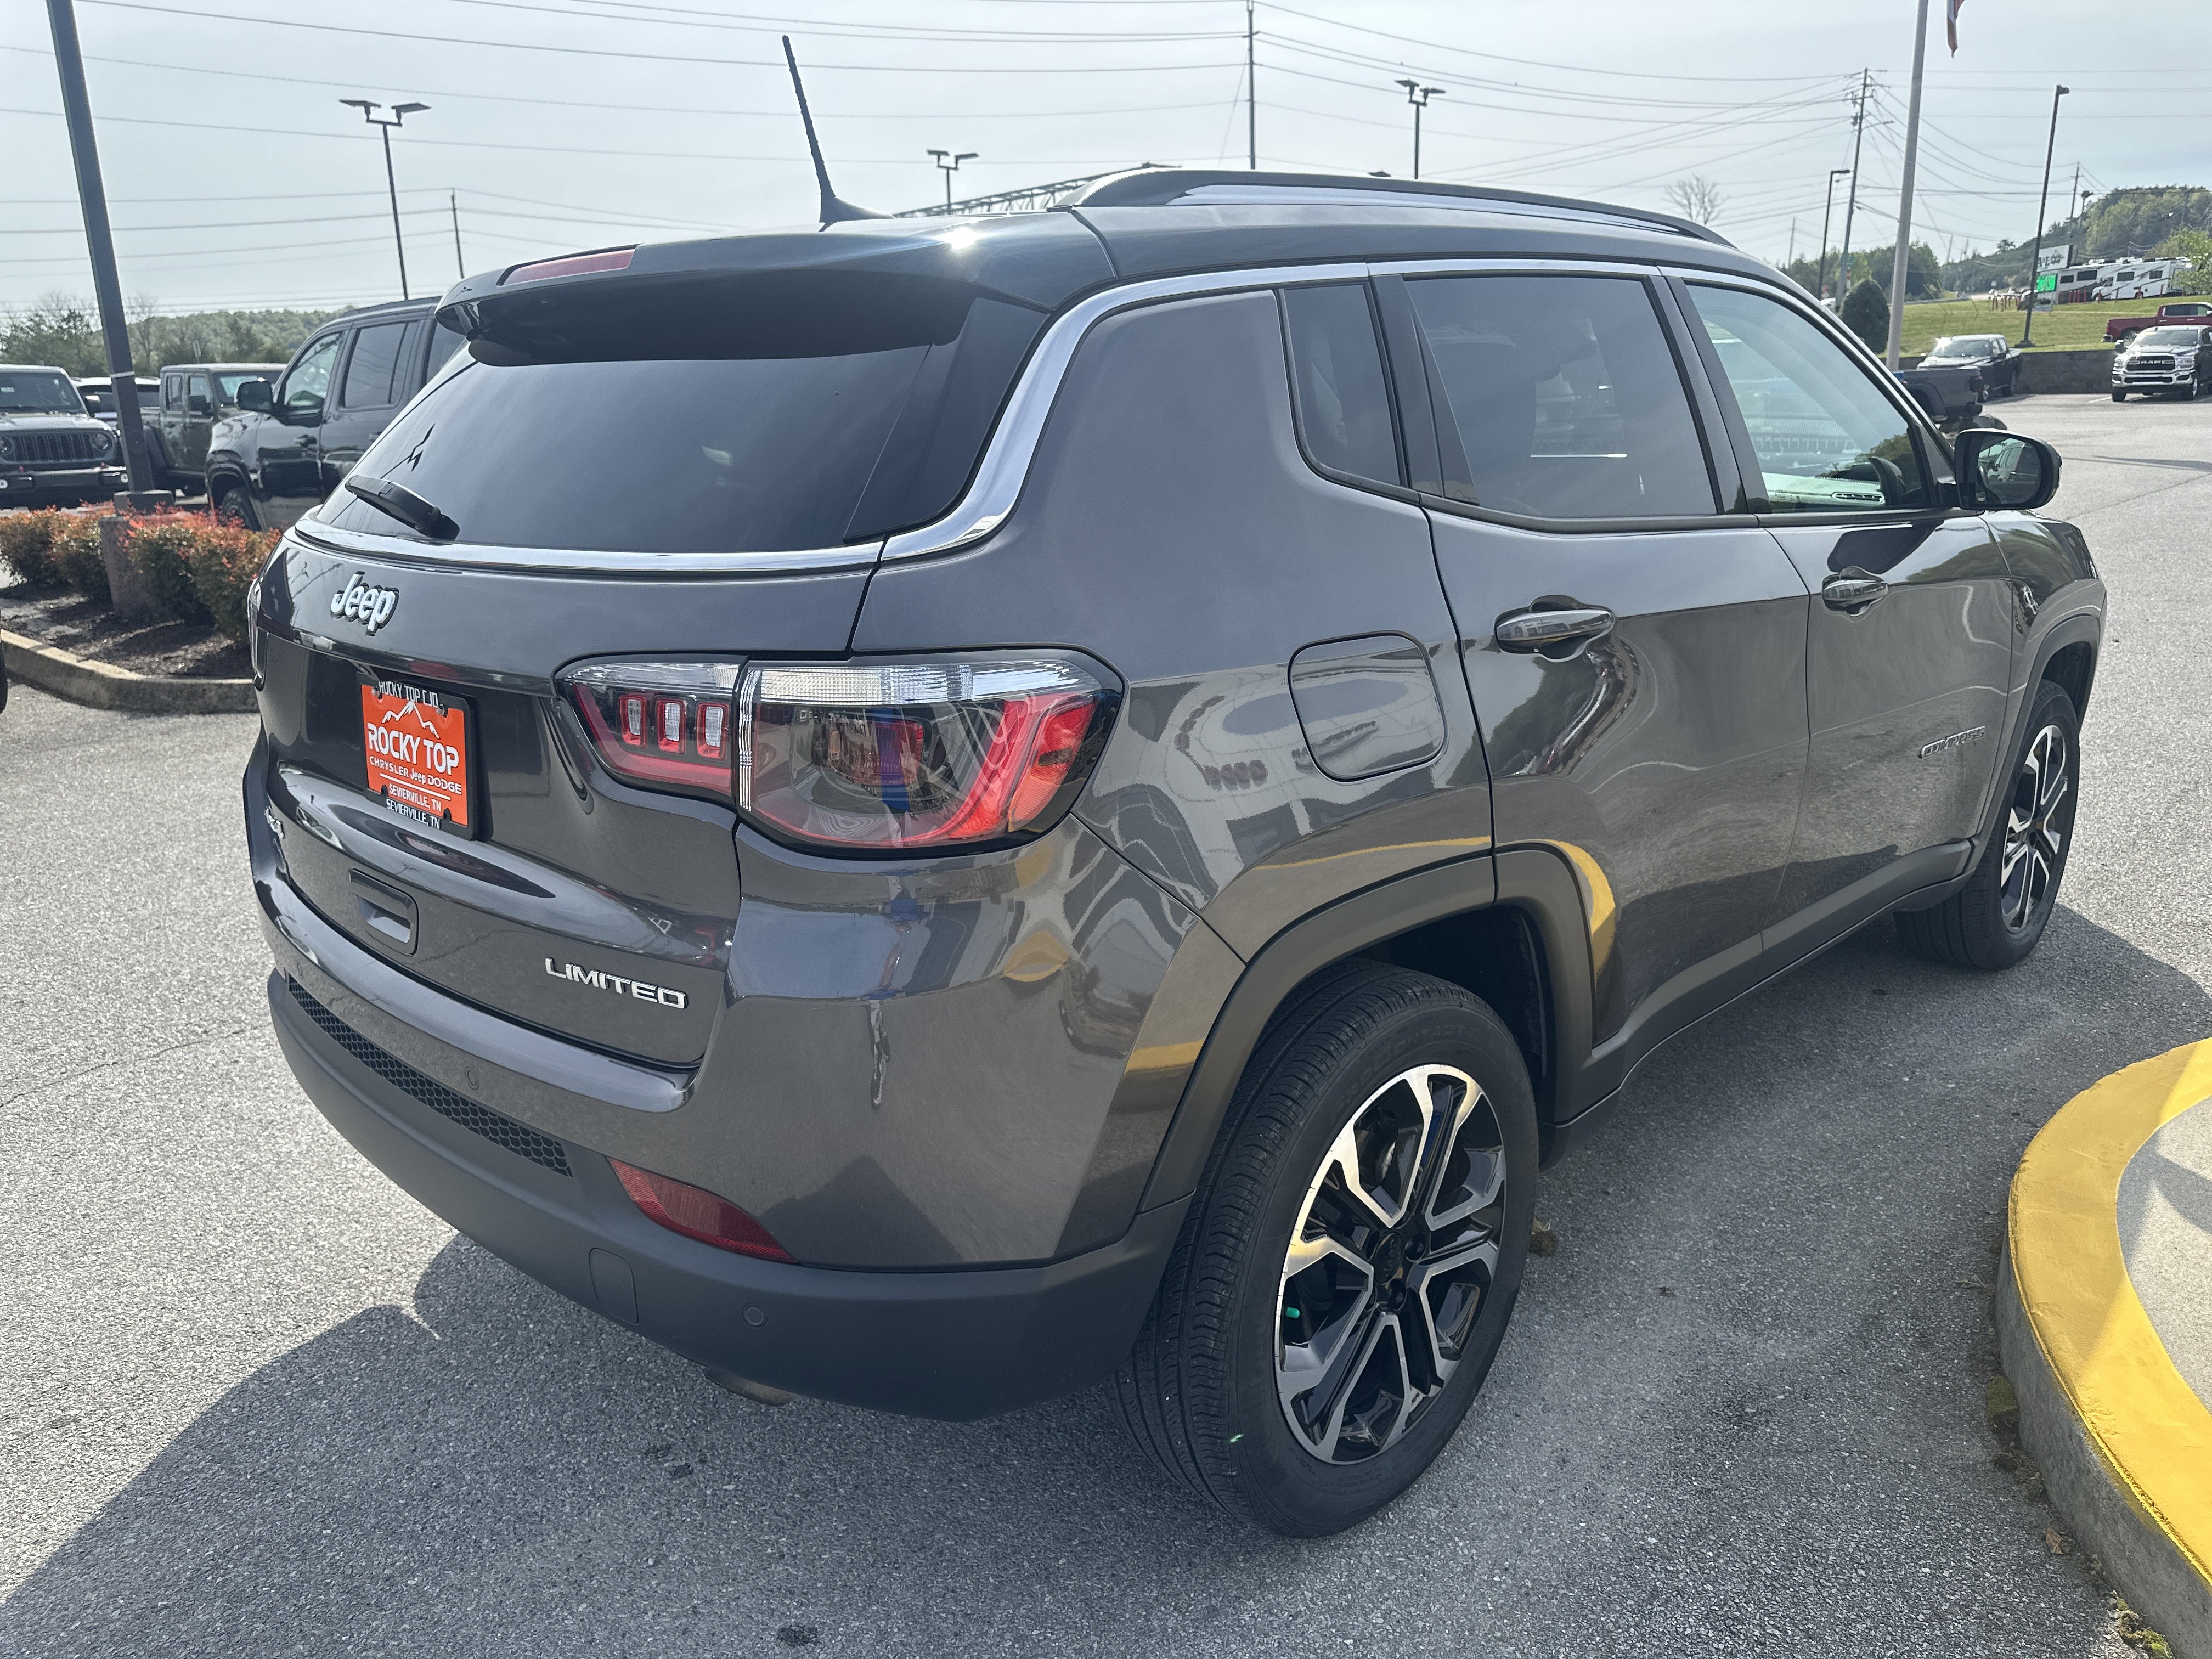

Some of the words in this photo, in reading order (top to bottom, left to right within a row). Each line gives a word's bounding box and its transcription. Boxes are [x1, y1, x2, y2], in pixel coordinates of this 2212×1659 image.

[331, 572, 398, 633] Jeep
[404, 685, 420, 703] TOP
[422, 690, 439, 708] CJD
[367, 722, 421, 765] ROCKY
[423, 738, 459, 775] TOP
[1920, 725, 1986, 759] COMPASS
[369, 755, 409, 778] CHRYSLER
[410, 768, 426, 785] Jeep
[427, 774, 462, 795] DODGE
[386, 798, 429, 826] SEVIERVILLE,
[430, 815, 440, 830] TN
[388, 783, 431, 810] SEVIERVILLE,
[432, 798, 442, 812] TN
[545, 957, 687, 1009] LIMITED
